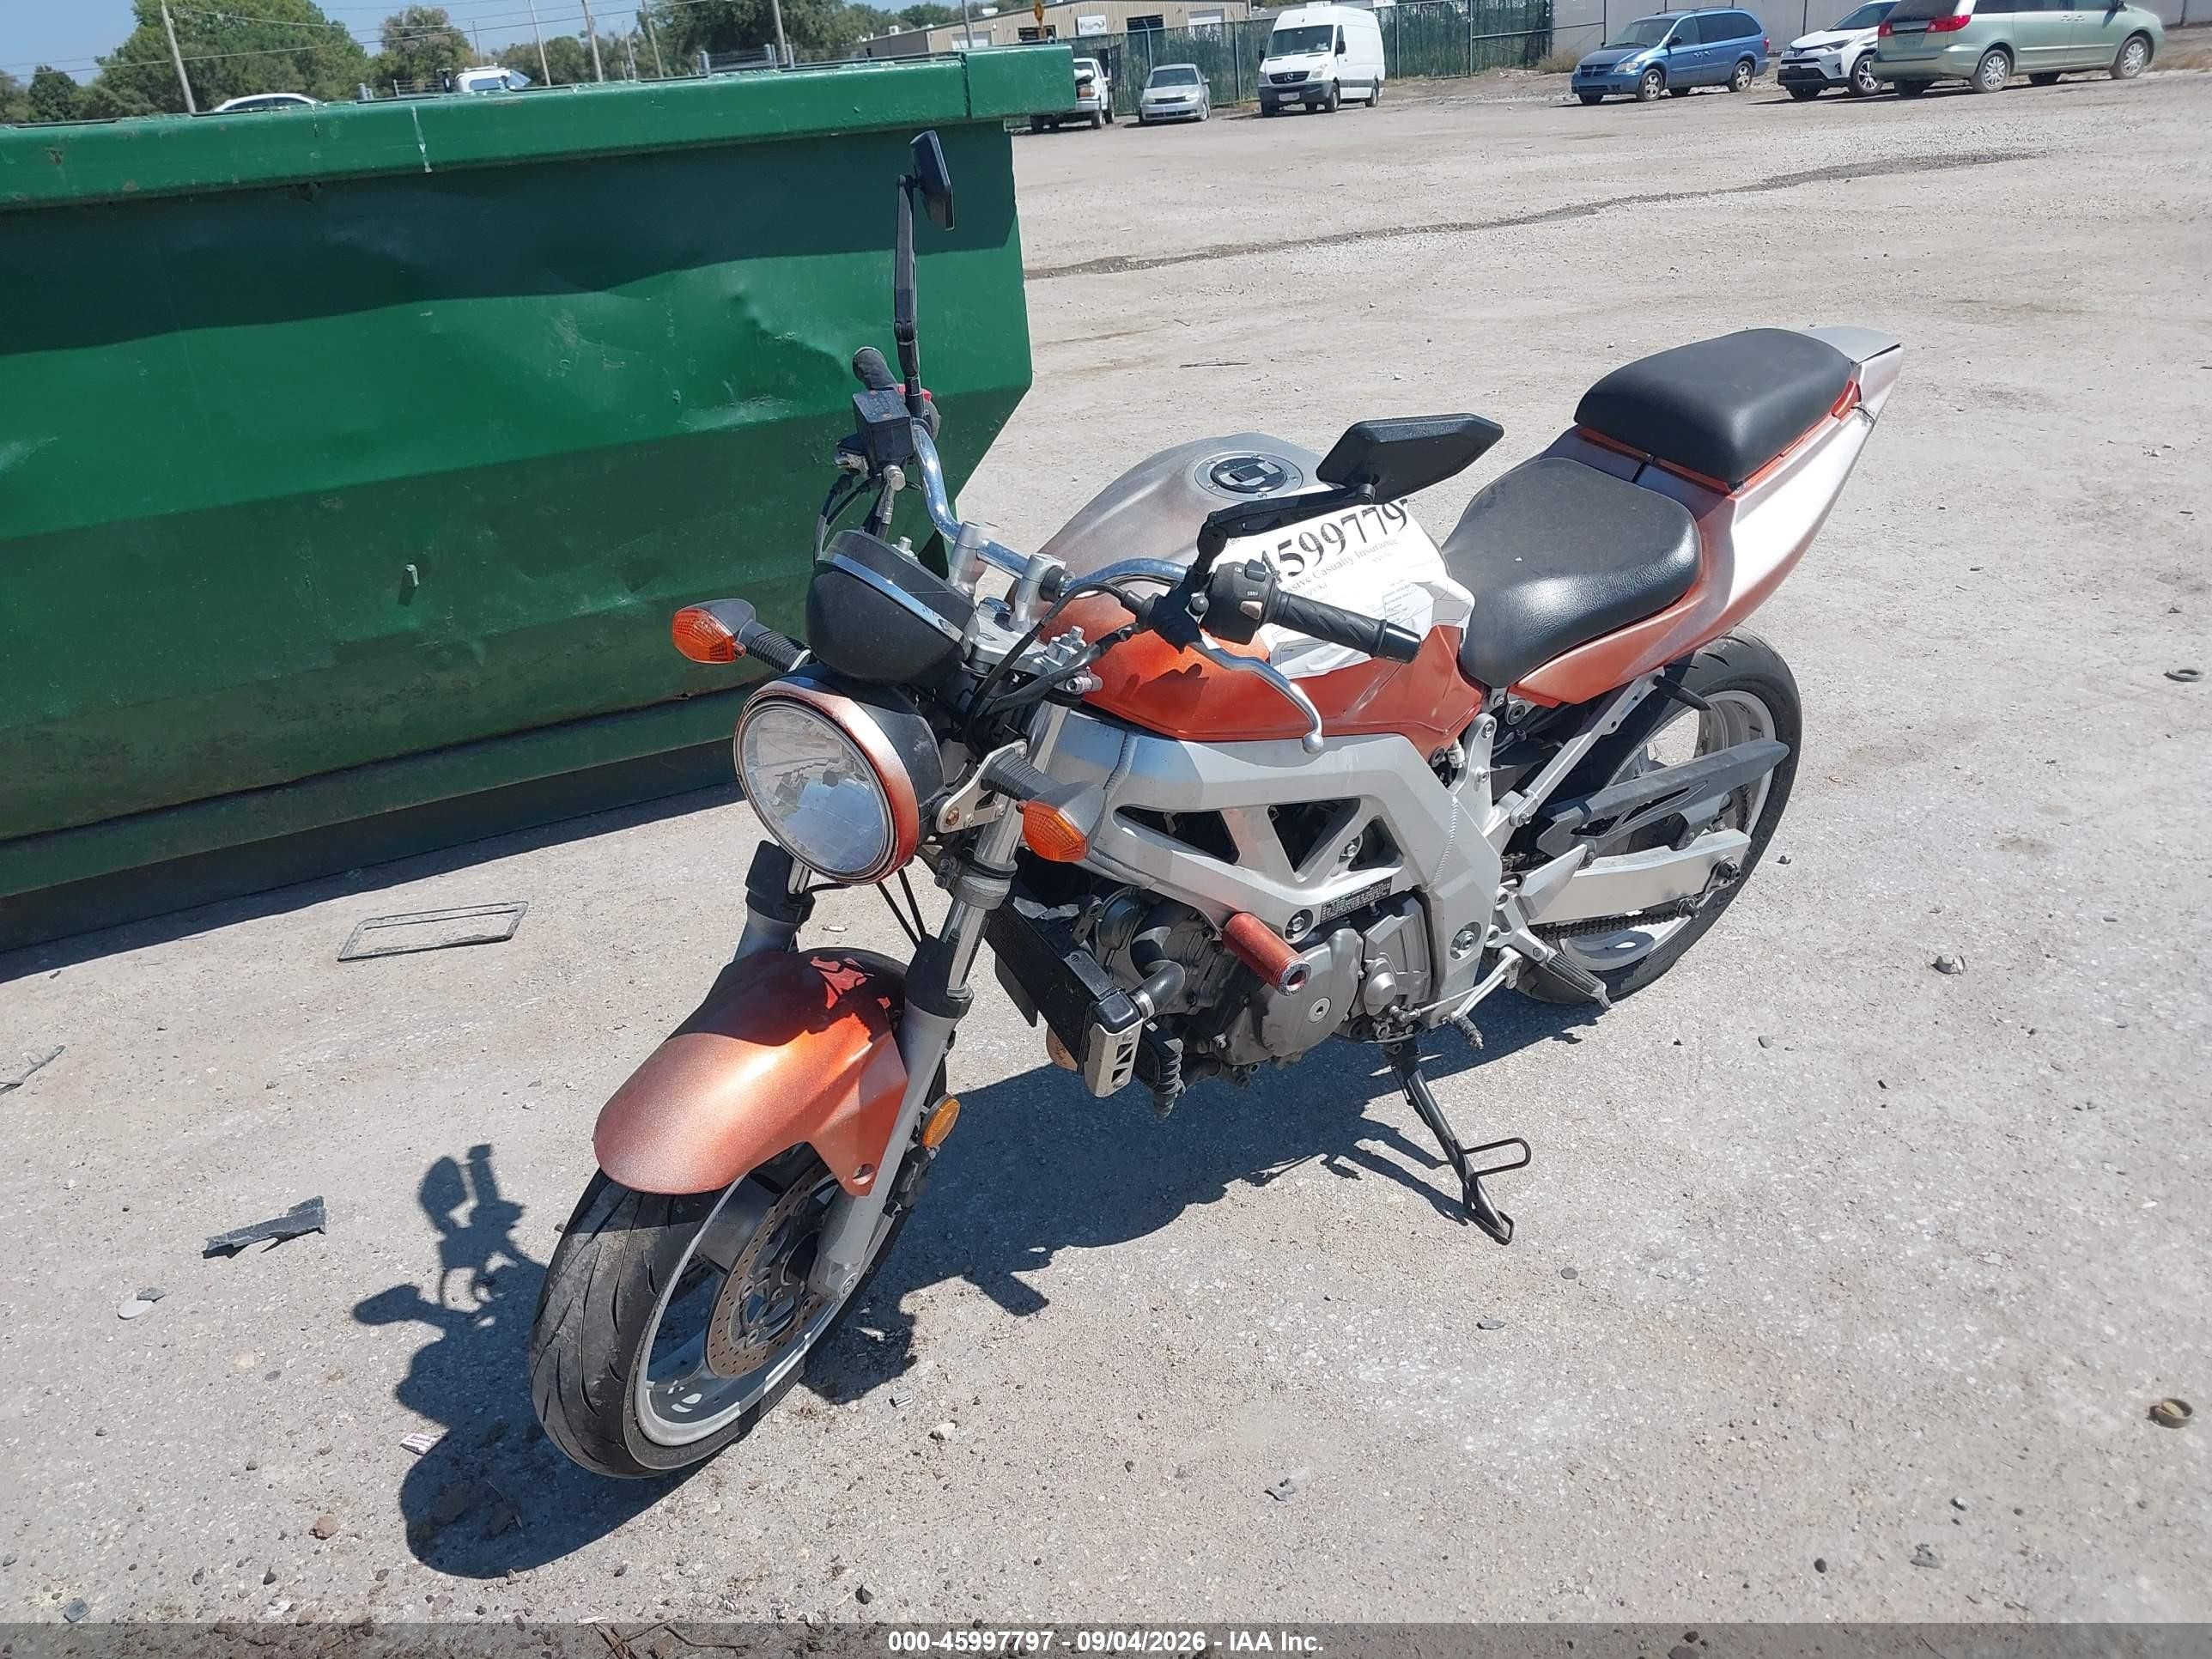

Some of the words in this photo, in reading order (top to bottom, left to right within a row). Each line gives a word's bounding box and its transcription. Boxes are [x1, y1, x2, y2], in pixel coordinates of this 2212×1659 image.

[1261, 498, 1409, 584] 599779
[1312, 556, 1354, 579] Casualty
[1354, 538, 1399, 559] Insurance
